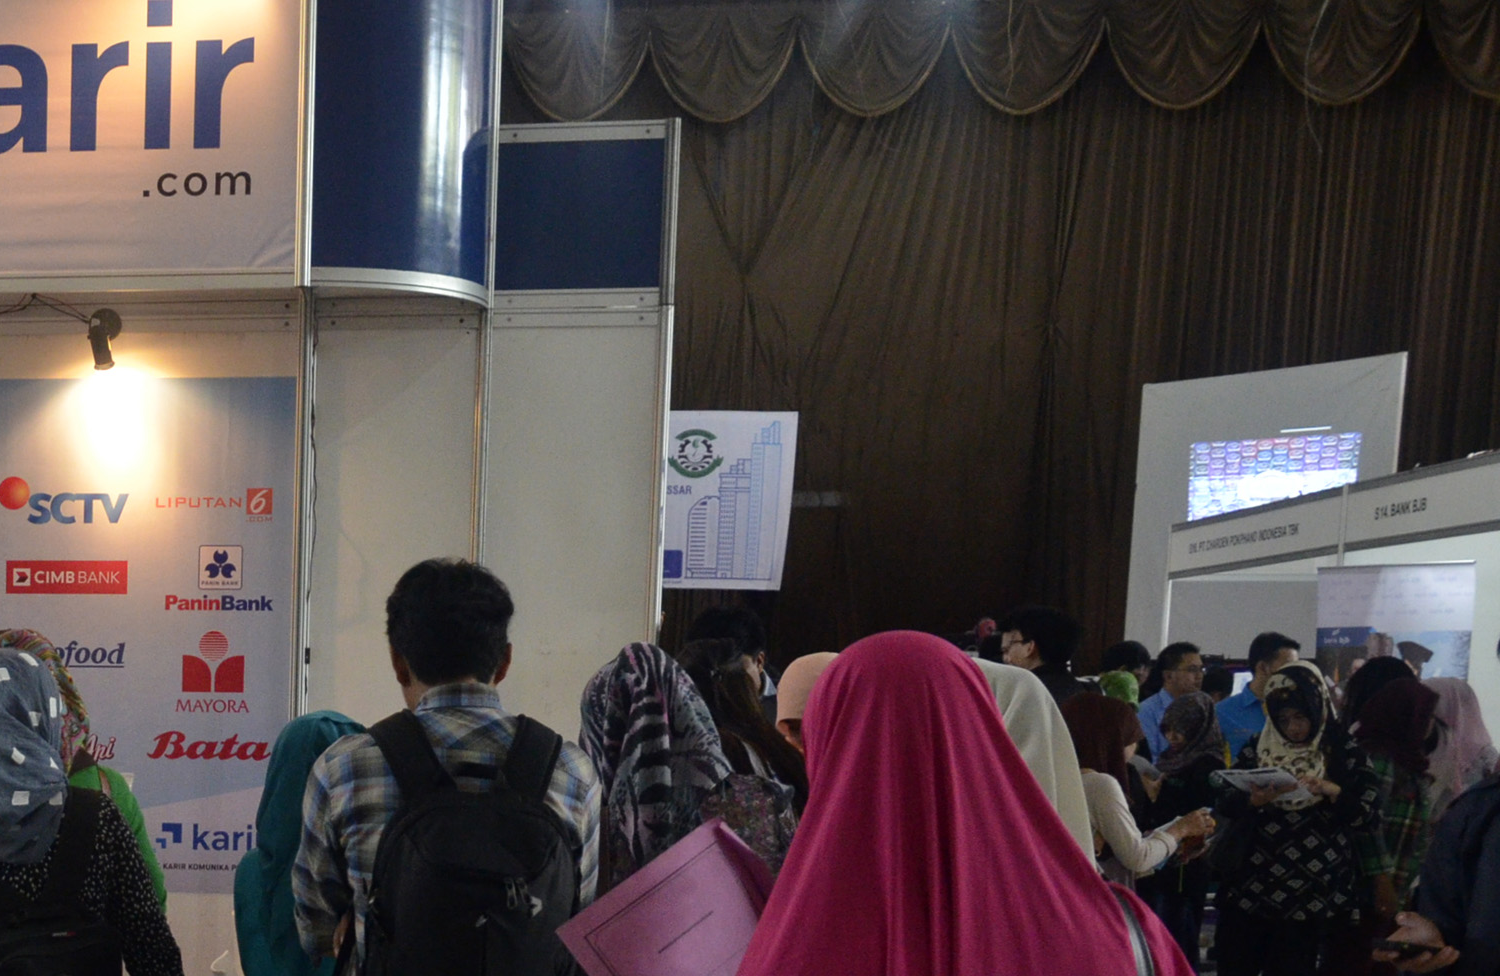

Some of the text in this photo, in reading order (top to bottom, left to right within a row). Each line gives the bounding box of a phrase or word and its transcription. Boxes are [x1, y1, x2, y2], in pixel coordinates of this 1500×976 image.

[142, 170, 252, 198] .com
[27, 492, 129, 524] SCTV
[155, 496, 243, 509] LIPUTAN
[34, 571, 120, 584] CIMB BANK
[165, 595, 273, 612] PaninBank
[55, 641, 125, 668] ofood
[175, 700, 249, 713] MAYORA
[147, 731, 271, 761] Bata
[192, 823, 254, 851] kari
[188, 863, 229, 871] KOMUNIKA
